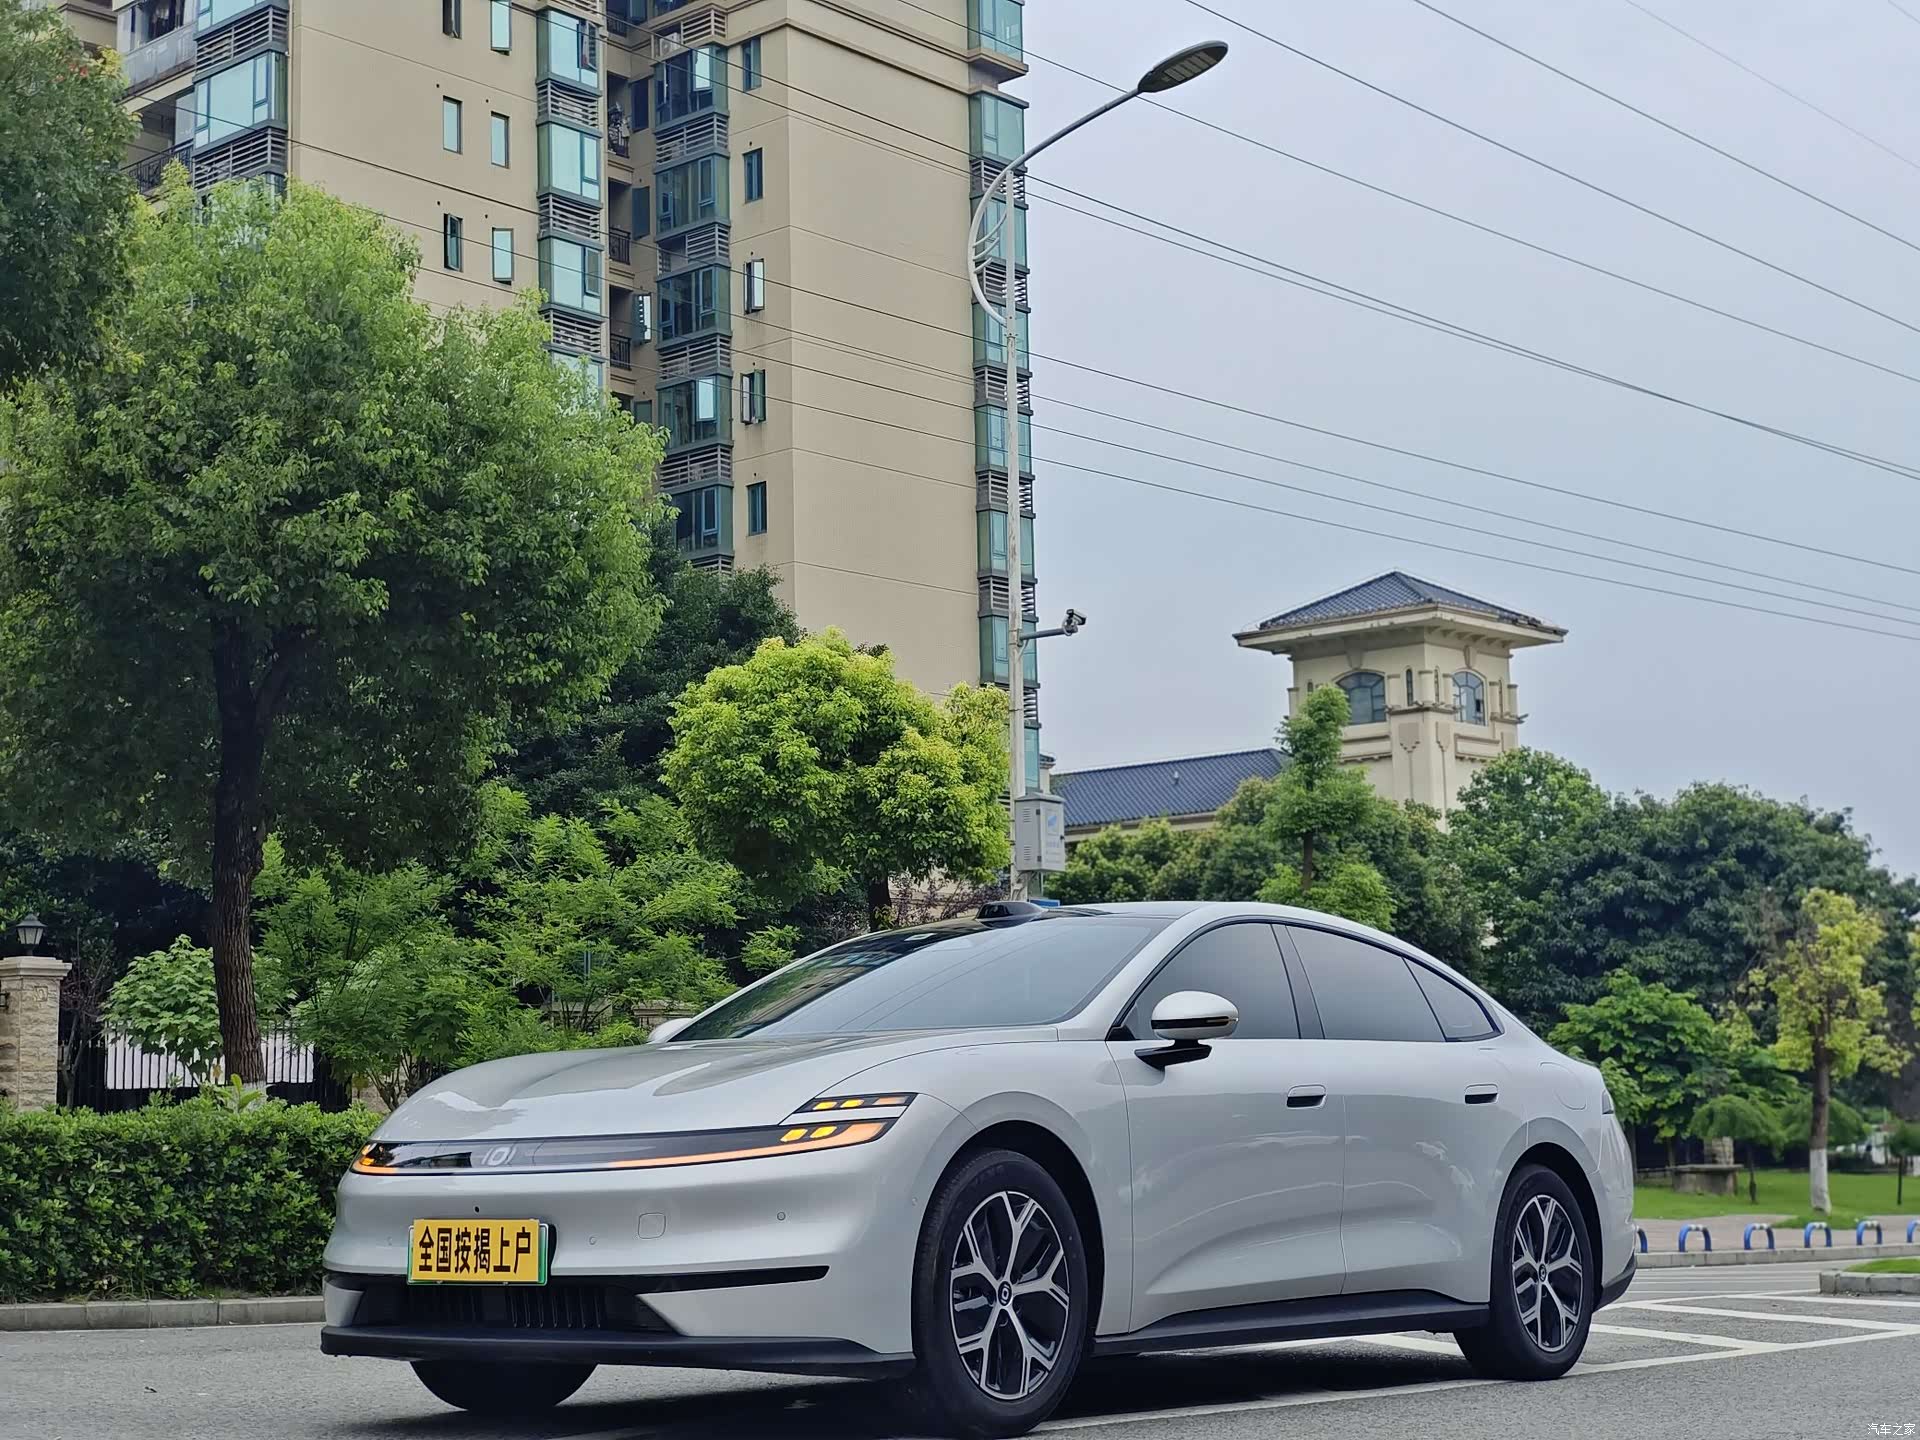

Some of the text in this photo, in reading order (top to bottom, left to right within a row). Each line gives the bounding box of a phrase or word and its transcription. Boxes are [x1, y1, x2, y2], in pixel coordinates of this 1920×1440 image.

[418, 1226, 531, 1274] 全国按揭上户
